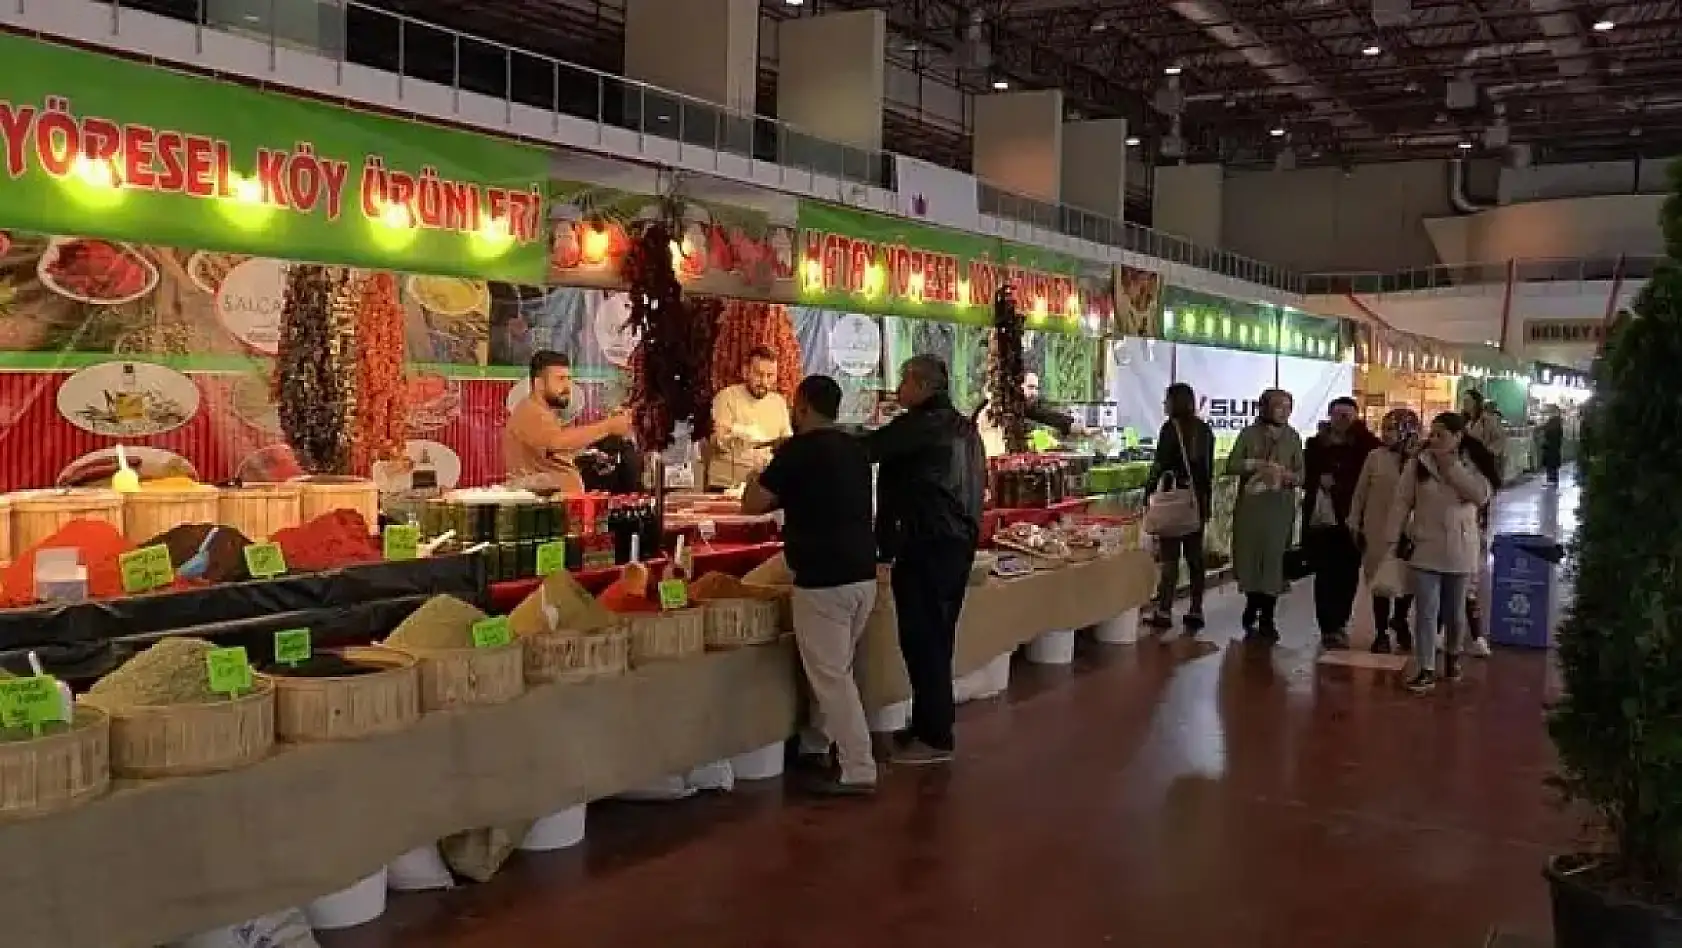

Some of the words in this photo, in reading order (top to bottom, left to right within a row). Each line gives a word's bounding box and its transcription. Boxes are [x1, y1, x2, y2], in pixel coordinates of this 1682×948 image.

[0, 95, 231, 200] YÖRESEL
[257, 141, 348, 222] KÖY
[361, 155, 541, 245] ÜRÜNLERİ
